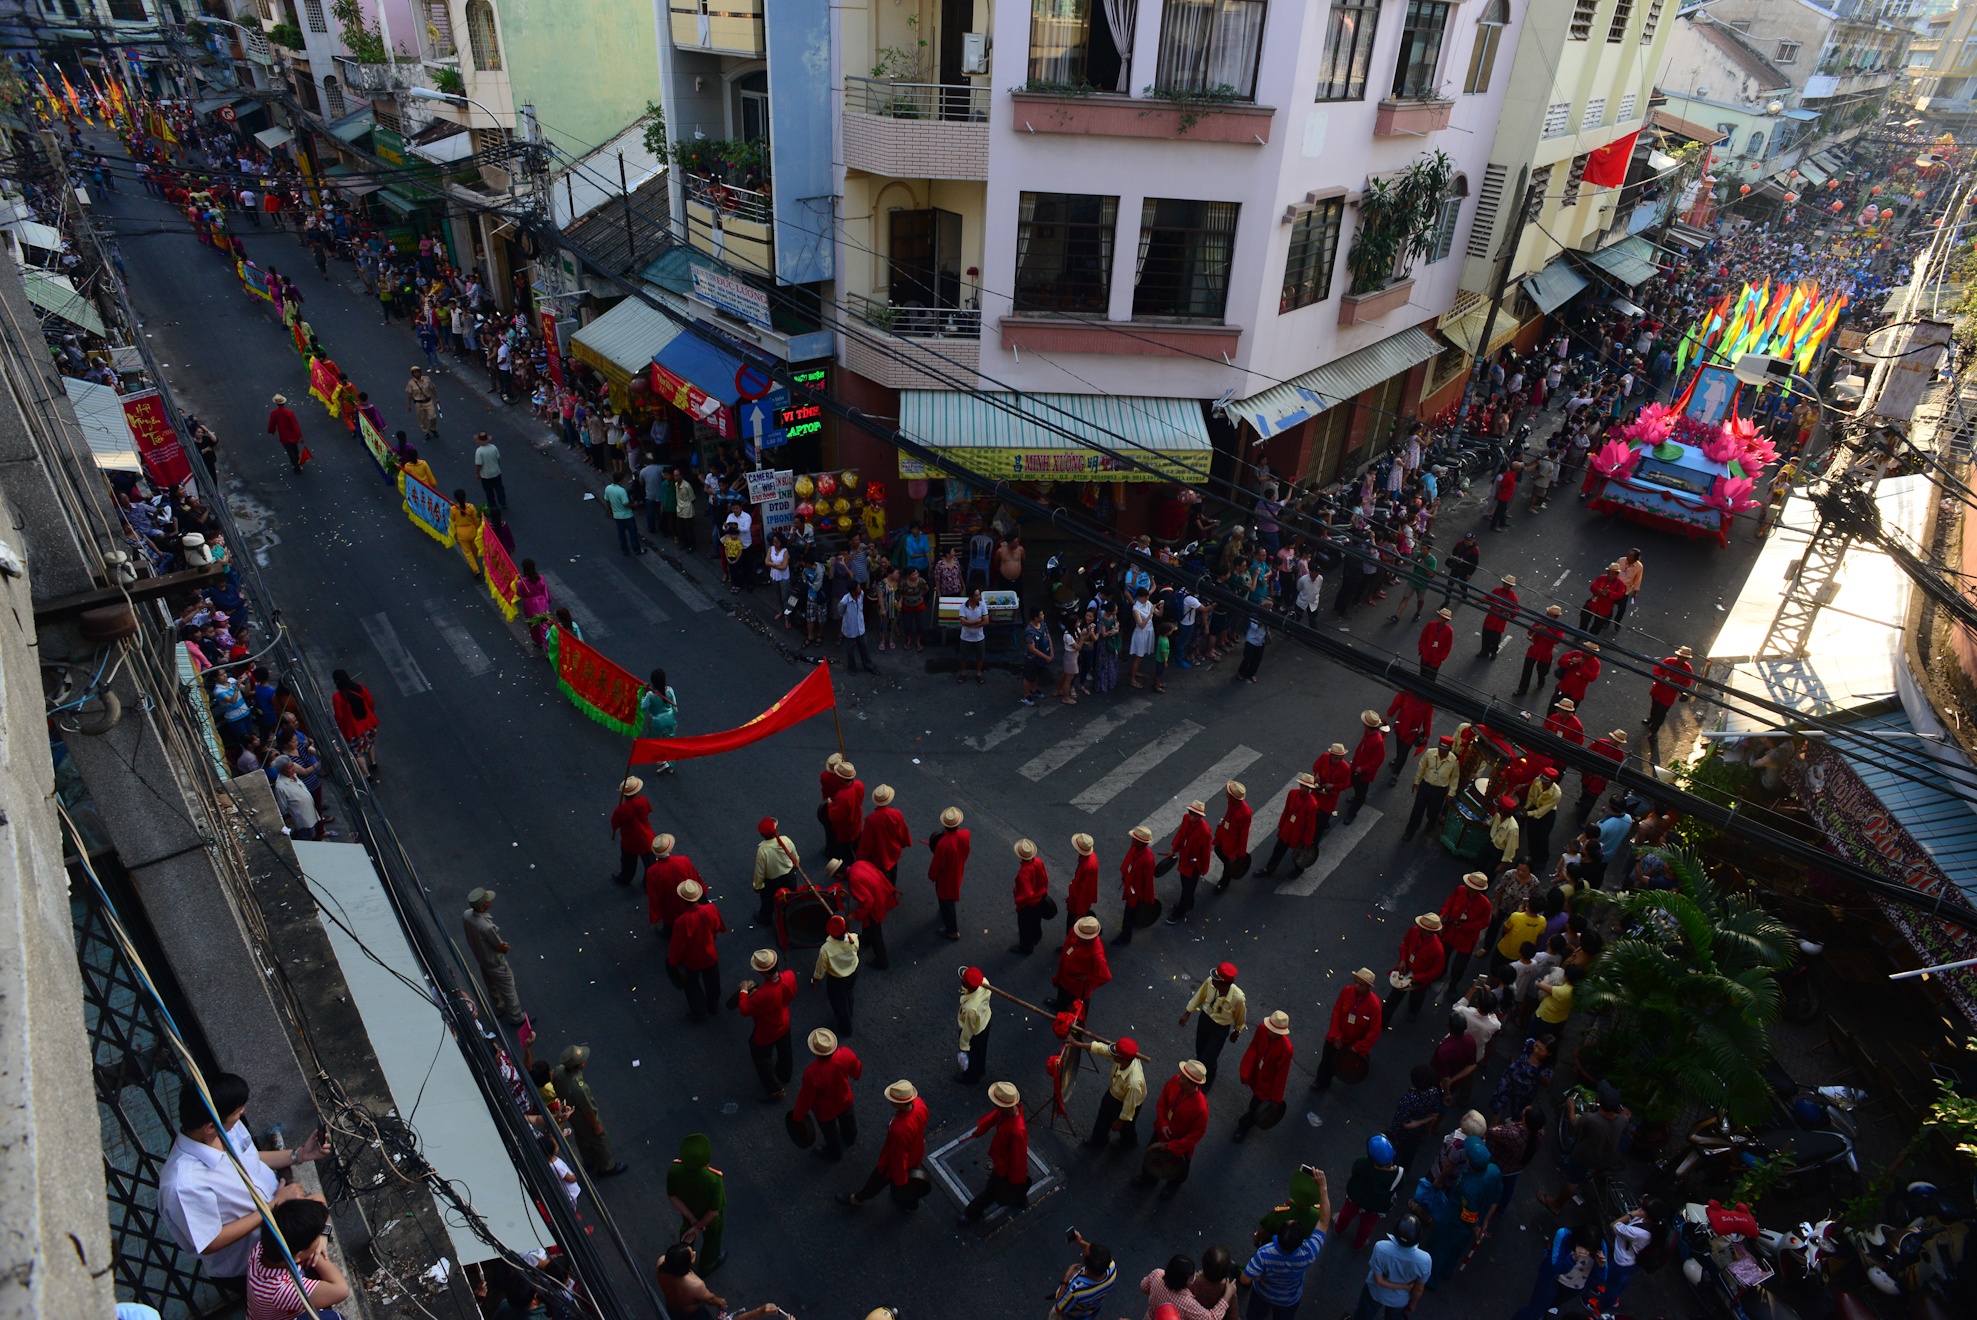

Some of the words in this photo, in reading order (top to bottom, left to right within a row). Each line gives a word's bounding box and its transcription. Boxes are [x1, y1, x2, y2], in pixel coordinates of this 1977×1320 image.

[1025, 454, 1050, 472] MINH
[1052, 452, 1085, 473] XƯƠNG
[748, 471, 774, 483] CAMERA
[766, 513, 794, 525] IPHONE
[1830, 771, 1866, 820] Coffee
